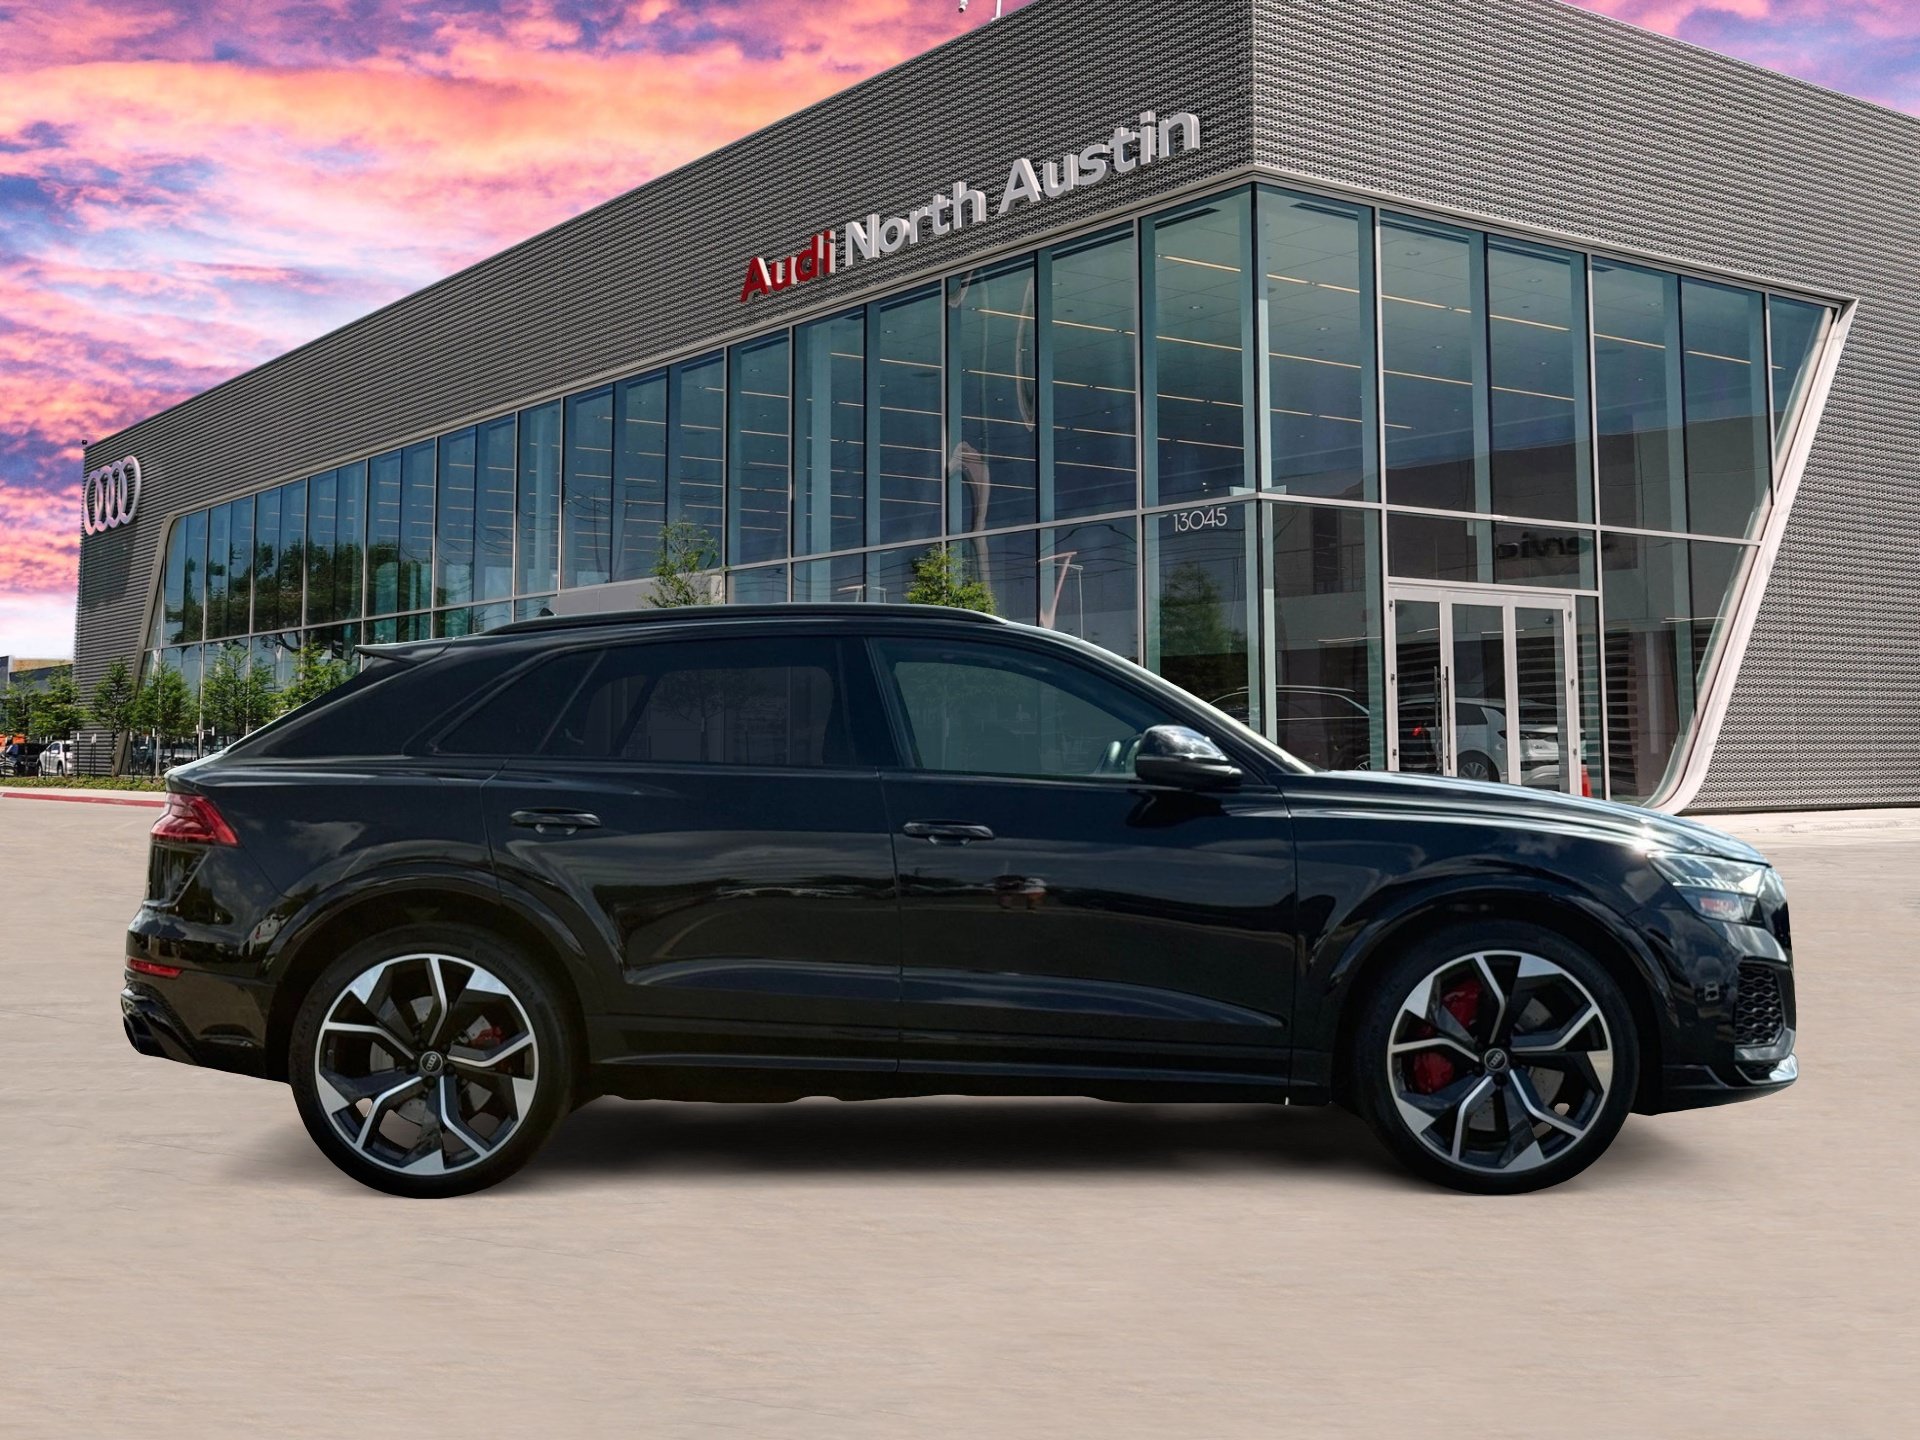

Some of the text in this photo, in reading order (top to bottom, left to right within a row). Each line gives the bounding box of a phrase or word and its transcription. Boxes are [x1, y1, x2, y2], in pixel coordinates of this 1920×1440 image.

[740, 110, 1200, 302] Audi North Austin
[1173, 507, 1228, 532] 13045
